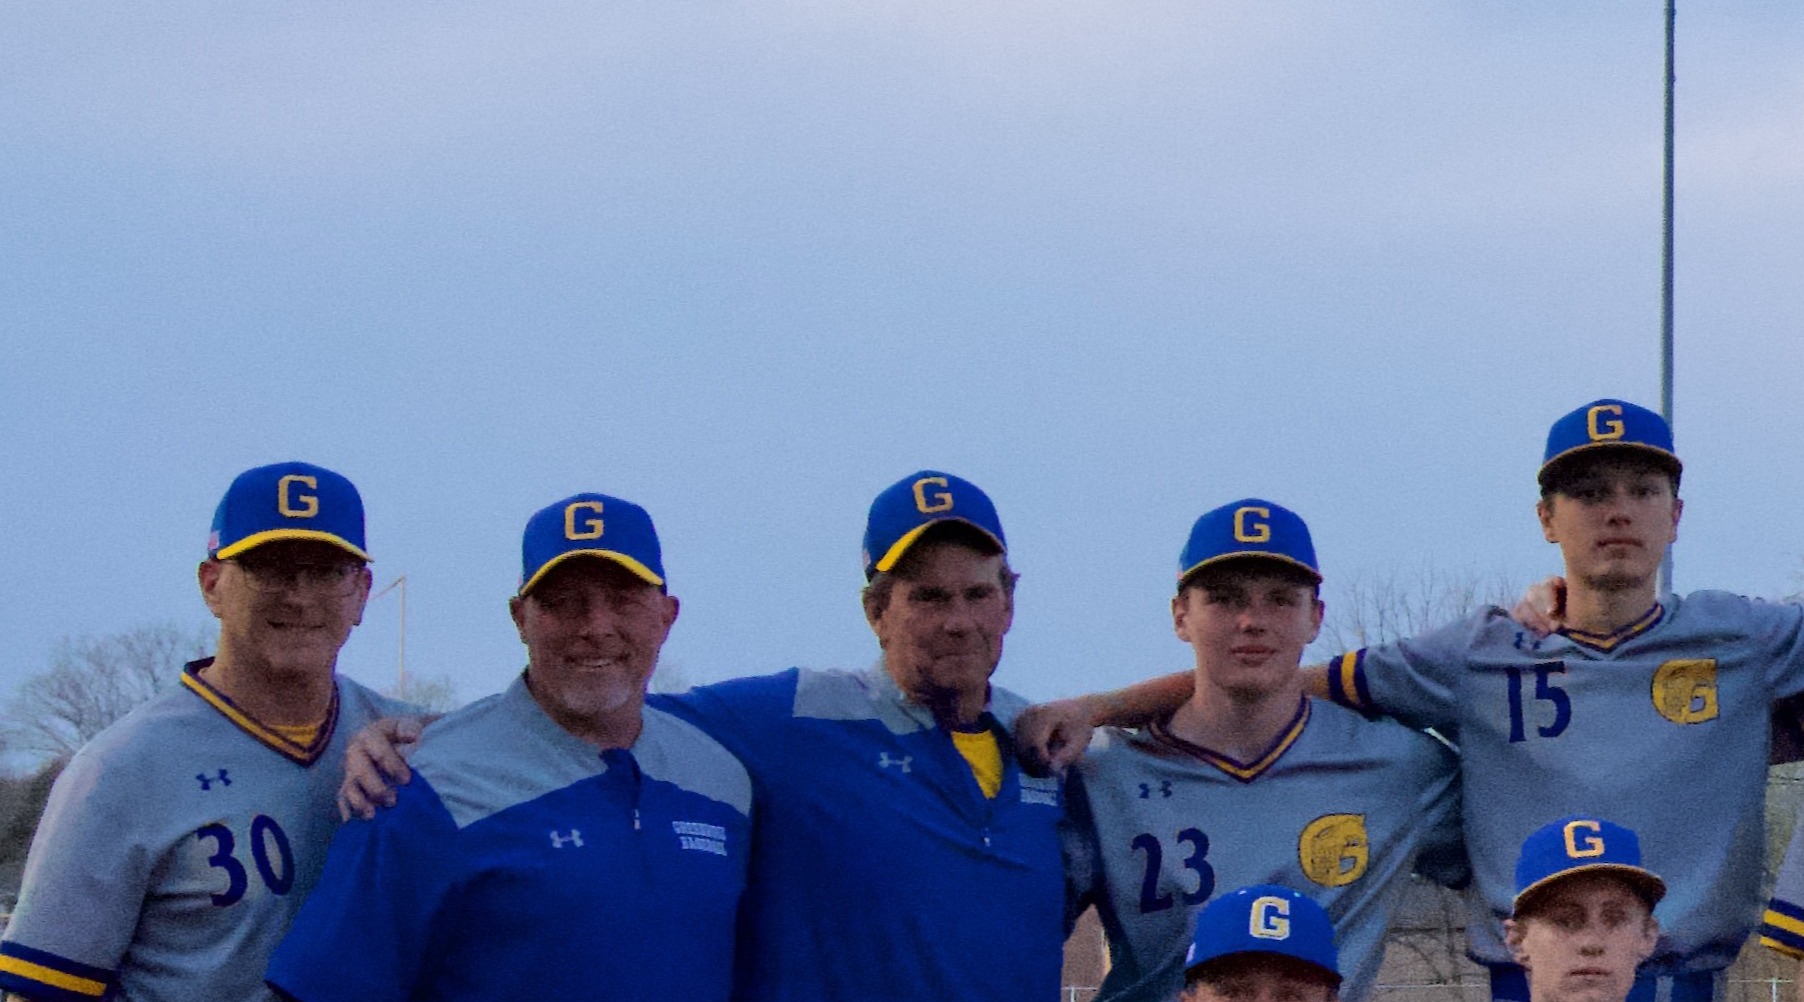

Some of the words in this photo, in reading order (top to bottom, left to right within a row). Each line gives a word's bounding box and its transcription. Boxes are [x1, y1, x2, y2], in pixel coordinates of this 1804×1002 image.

[1587, 404, 1625, 442] G
[279, 475, 319, 518] G
[911, 477, 954, 514] G
[565, 502, 604, 541] G
[1233, 507, 1270, 543] G
[1505, 661, 1572, 743] 15
[197, 813, 295, 908] 30
[1565, 821, 1605, 859] G
[1130, 827, 1216, 914] 23
[1250, 896, 1291, 940] G
